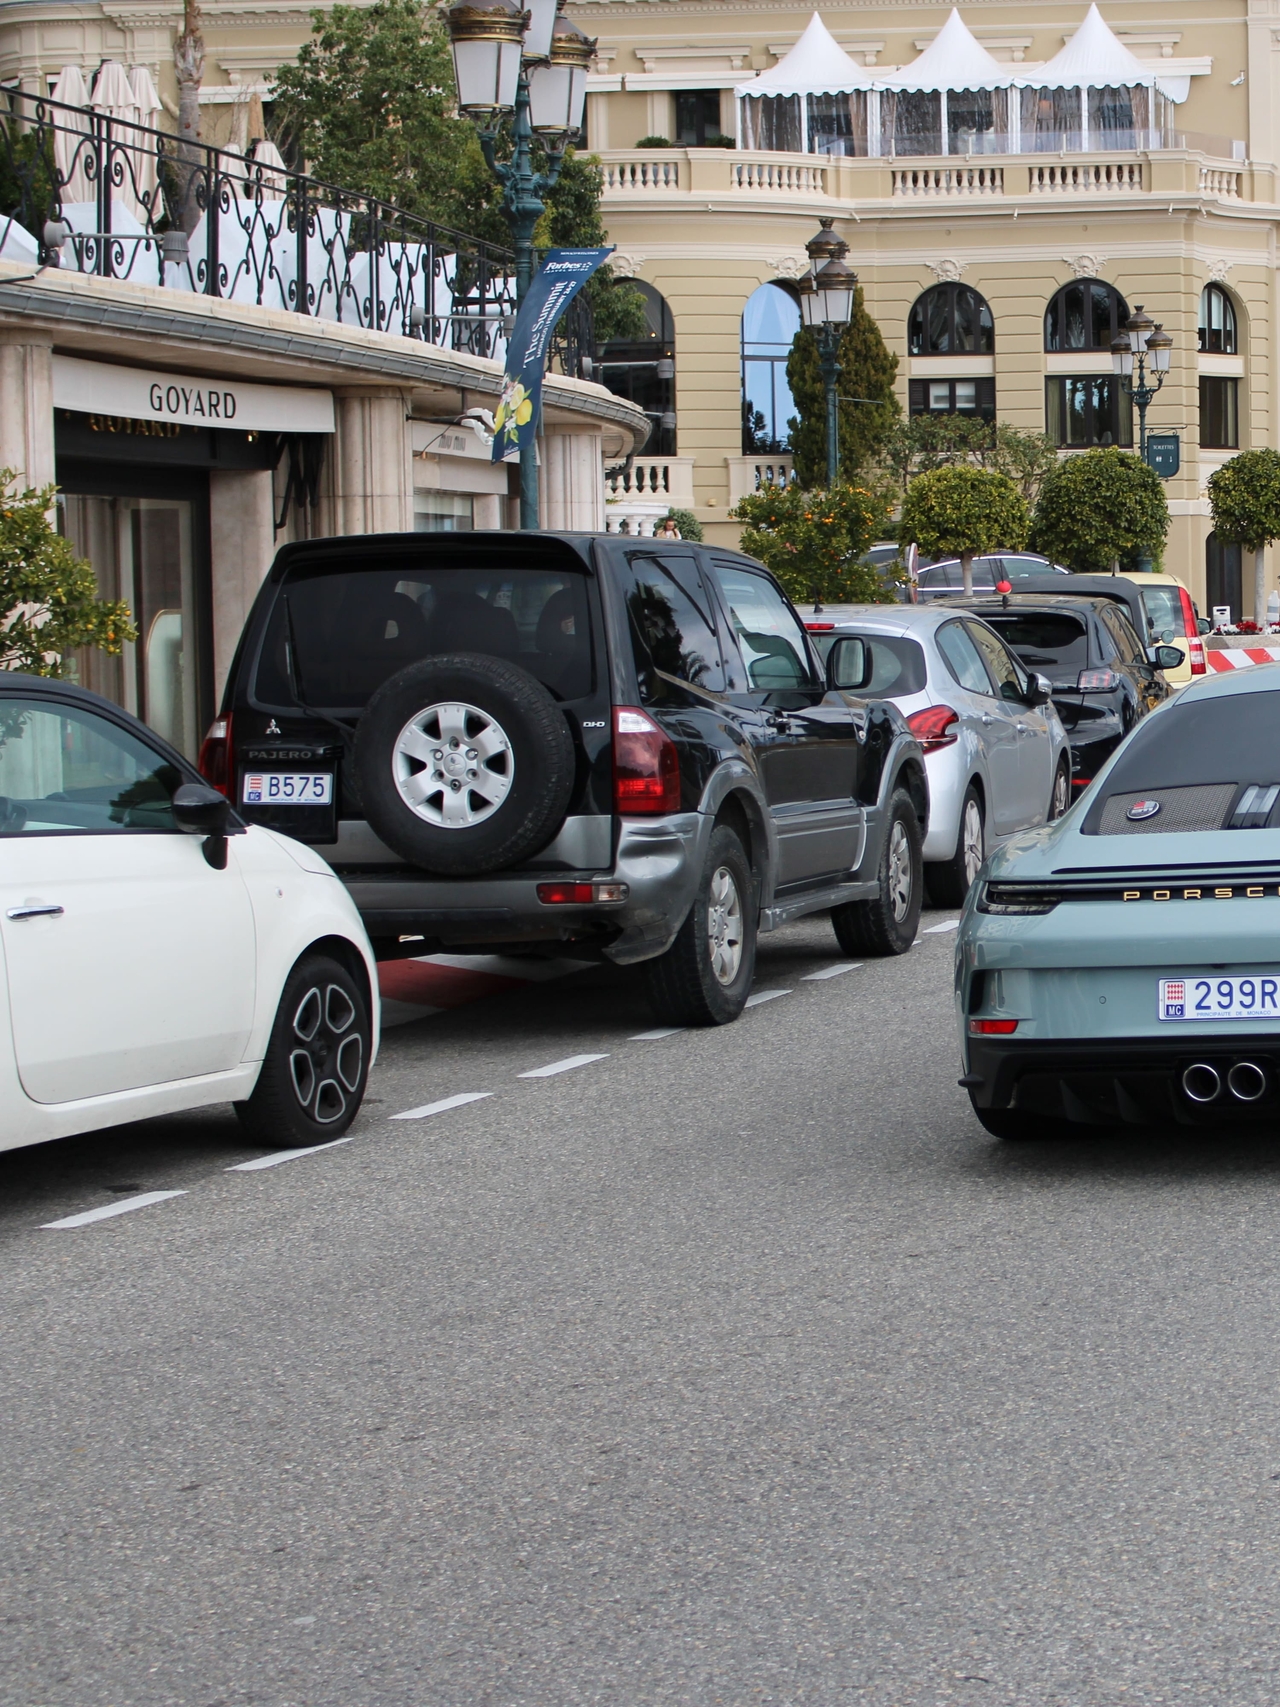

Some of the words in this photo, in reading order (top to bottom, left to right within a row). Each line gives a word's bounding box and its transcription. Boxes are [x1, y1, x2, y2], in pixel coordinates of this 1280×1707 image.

[545, 261, 581, 271] Forbes
[523, 332, 540, 368] The
[532, 281, 568, 332] Summit
[150, 383, 236, 419] GOYARD
[249, 750, 312, 759] PAJERO
[269, 776, 325, 797] B575
[250, 792, 260, 800] MC
[1195, 980, 1278, 1010] 299R
[1168, 1005, 1182, 1015] MC
